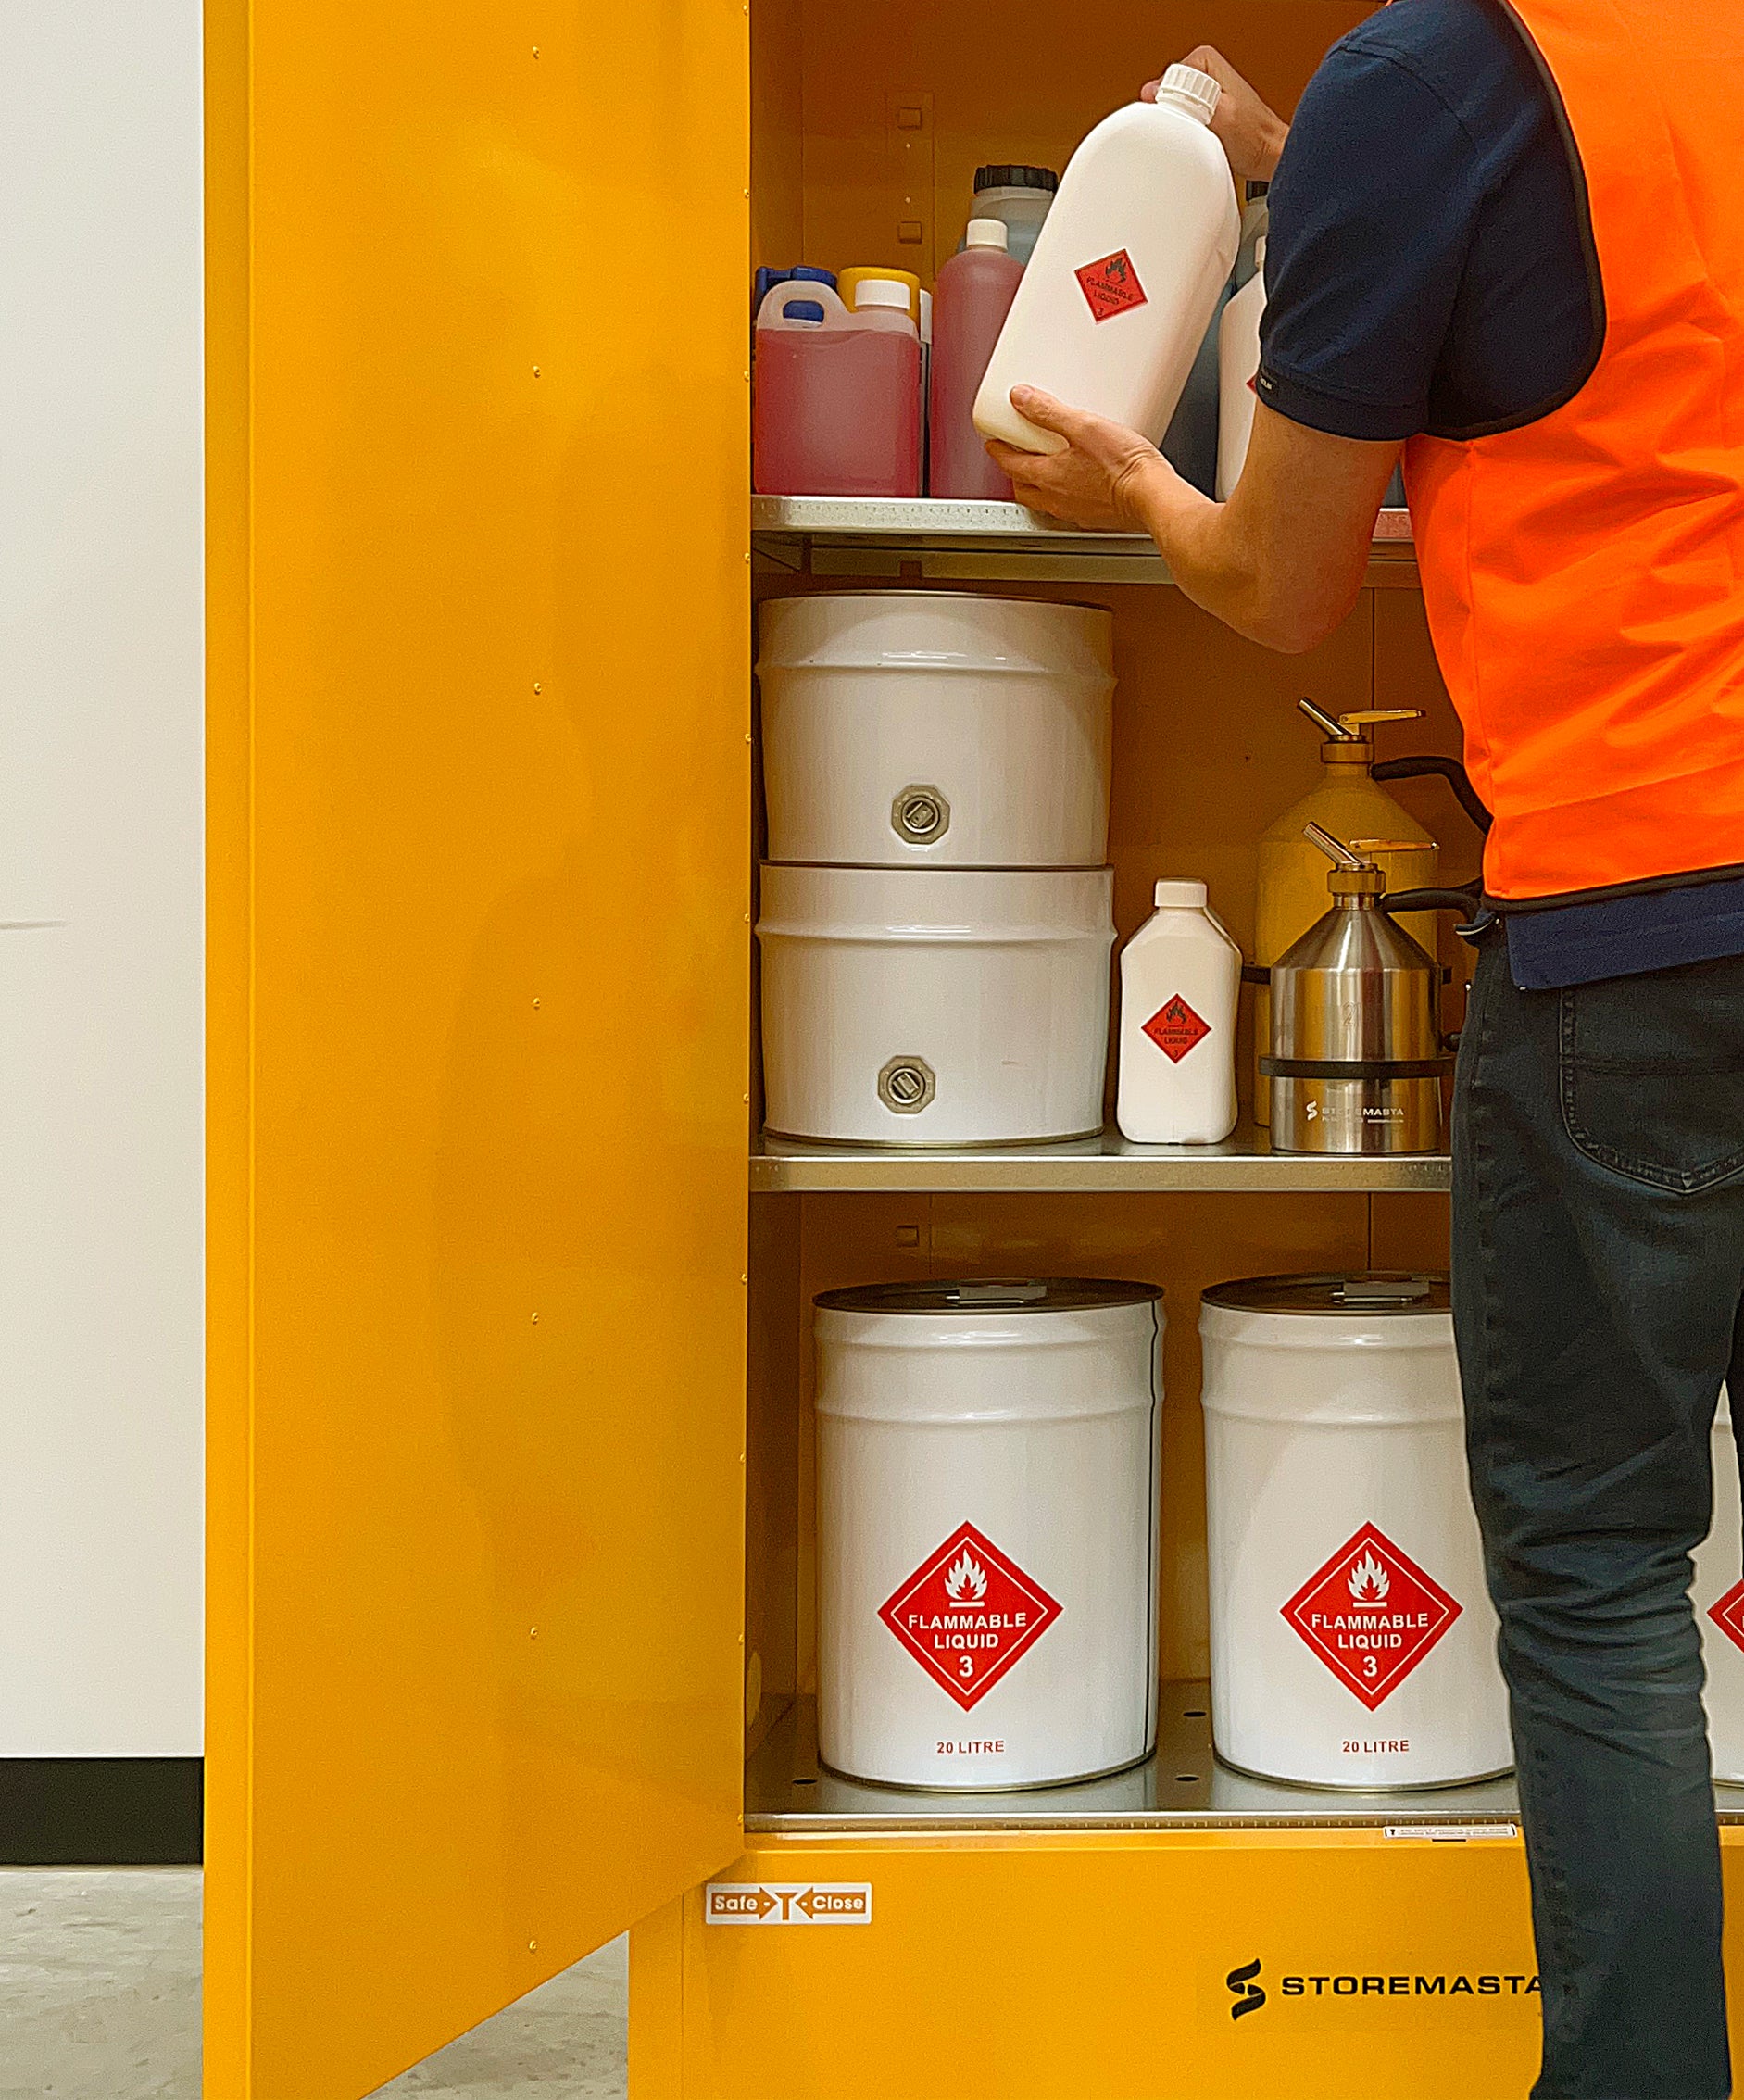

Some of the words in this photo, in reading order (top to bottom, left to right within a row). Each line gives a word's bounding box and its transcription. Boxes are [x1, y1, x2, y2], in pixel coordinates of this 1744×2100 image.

[1154, 1027, 1198, 1036] FLAMMABLE
[1322, 1107, 1404, 1116] STEMASTA
[908, 1612, 1027, 1630] FLAMMABLE
[1311, 1612, 1429, 1629] FLAMMABLE
[934, 1633, 999, 1650] LIQUID
[1337, 1633, 1402, 1650] LIQUID
[959, 1655, 973, 1678] 3
[1362, 1655, 1378, 1677] 3
[936, 1741, 954, 1754] 20
[958, 1741, 1004, 1754] LITRE
[1342, 1740, 1360, 1753] 20
[1363, 1740, 1410, 1753] LITRE
